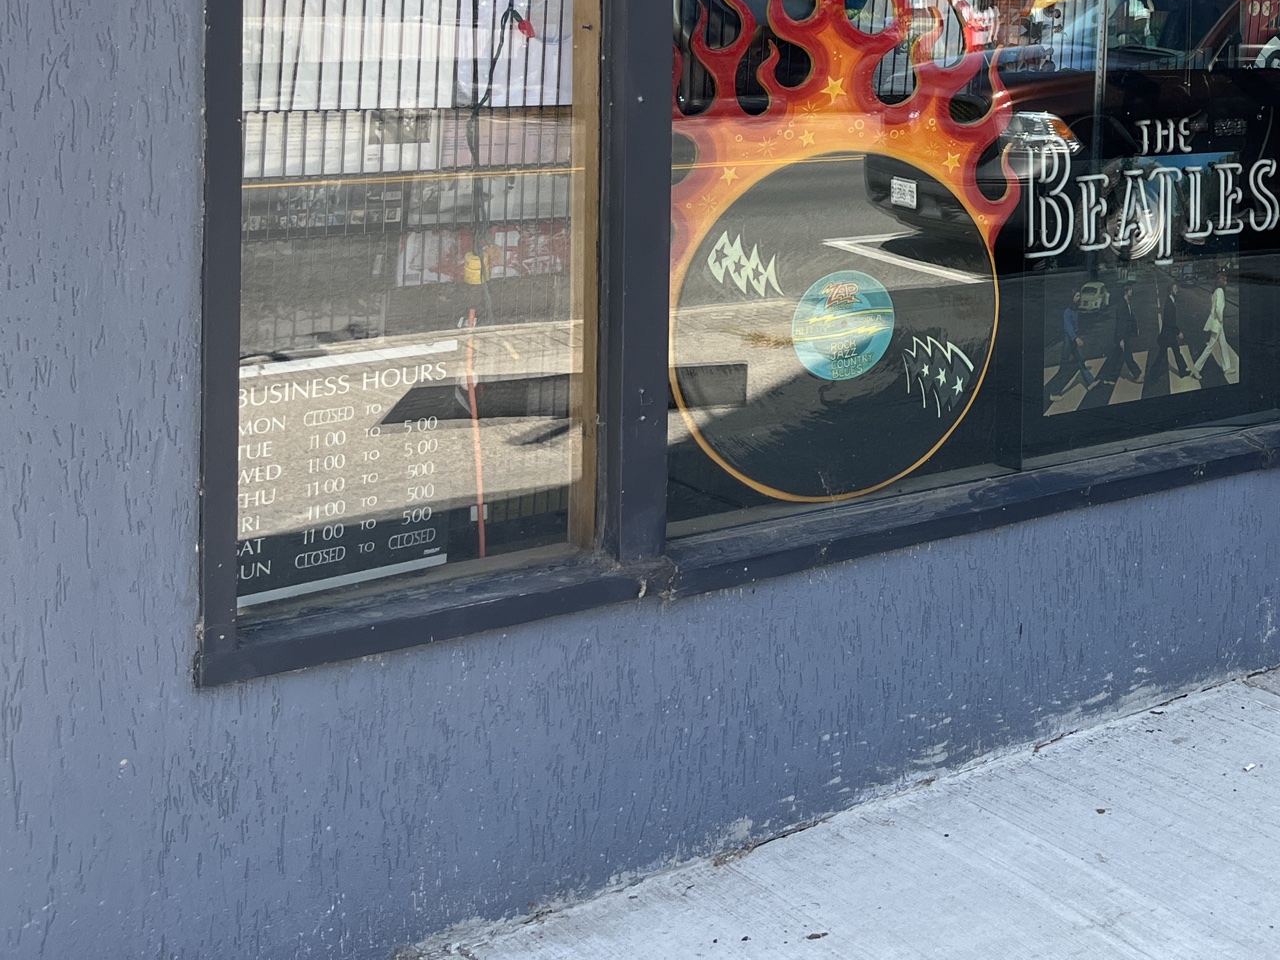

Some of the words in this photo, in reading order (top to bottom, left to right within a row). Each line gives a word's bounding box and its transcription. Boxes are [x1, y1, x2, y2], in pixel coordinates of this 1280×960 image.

[1134, 117, 1192, 155] THE
[1024, 134, 1280, 266] BEATLES
[822, 282, 861, 310] ZAP
[830, 340, 856, 351] ROCK
[830, 348, 858, 361] JAZZ
[831, 352, 873, 369] COUNTRY
[362, 361, 447, 391] HOURS
[832, 365, 863, 379] BLUES
[238, 415, 286, 437] MON
[304, 406, 355, 427] CLOSED
[366, 403, 382, 416] TO
[364, 426, 381, 438] TO
[362, 450, 380, 461] TO
[362, 473, 379, 484] TO
[360, 496, 378, 507] TO
[236, 538, 265, 557] AT
[360, 518, 377, 531] TO
[236, 560, 271, 580] UN
[294, 546, 346, 570] CLOSED
[358, 541, 375, 553] TO
[388, 527, 436, 551] CLOSED
